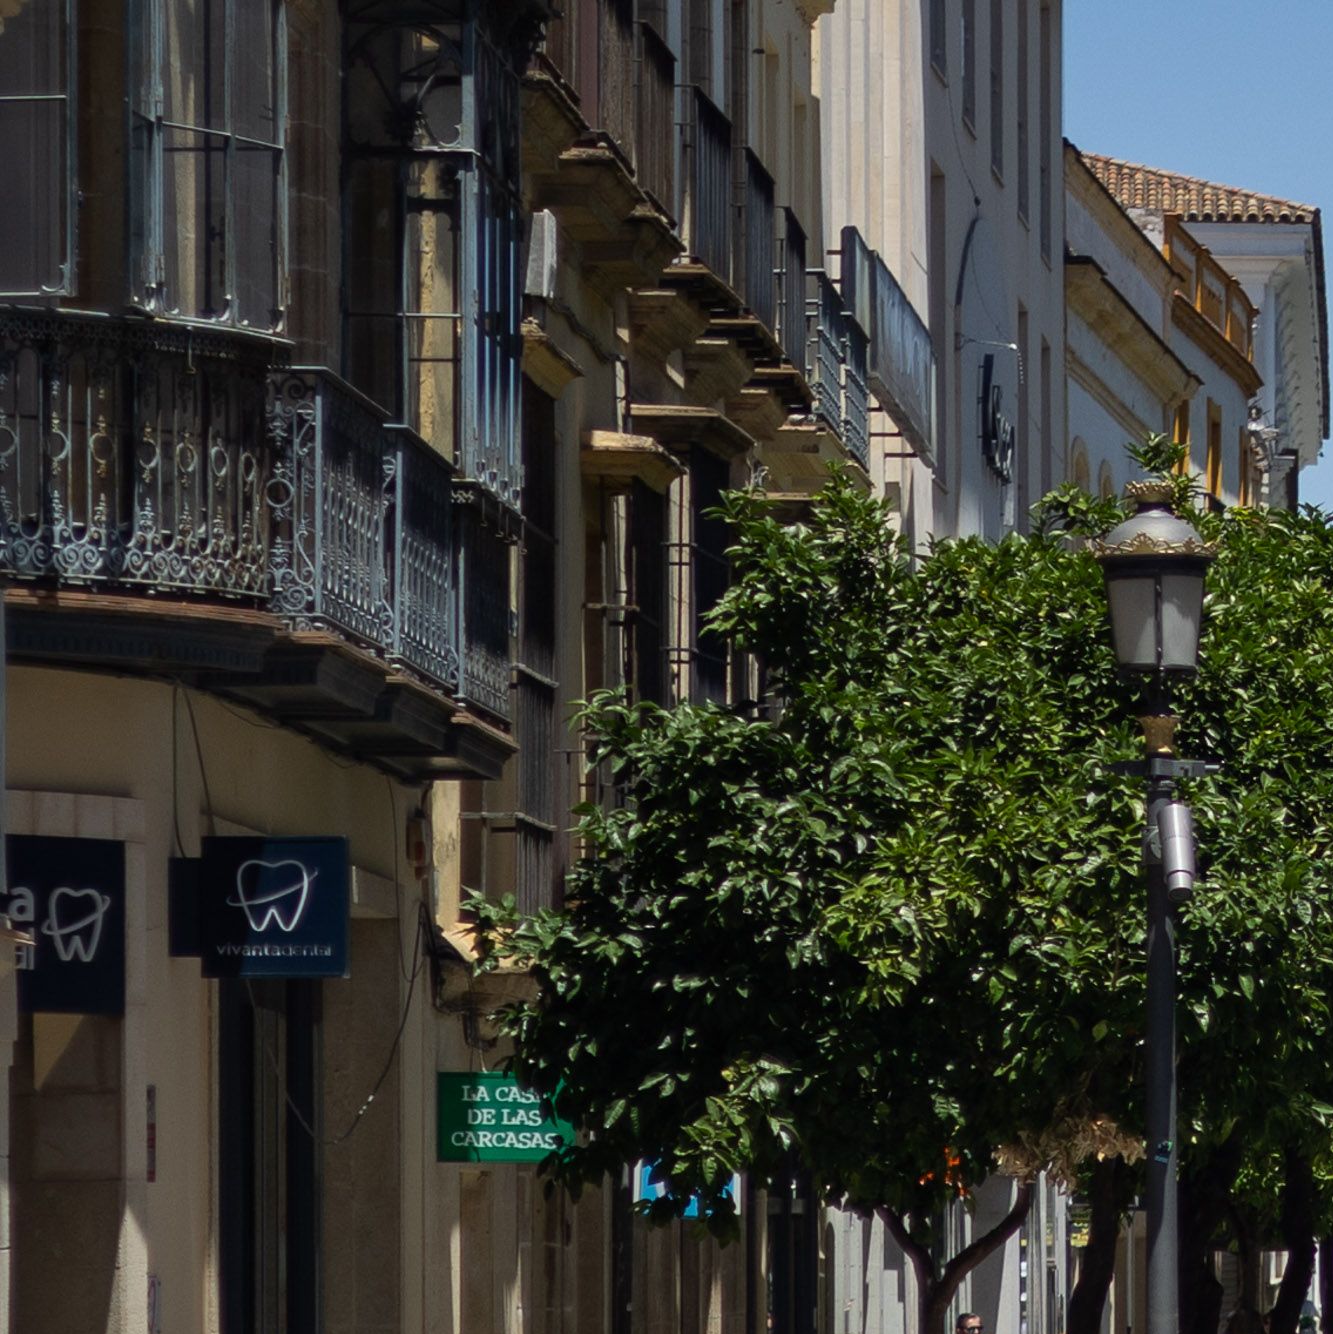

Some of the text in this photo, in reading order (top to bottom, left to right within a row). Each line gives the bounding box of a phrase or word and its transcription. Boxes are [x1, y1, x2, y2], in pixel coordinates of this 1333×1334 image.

[217, 942, 331, 956] vivantadental
[462, 1085, 541, 1103] LA CAS
[467, 1108, 542, 1127] DE LAS
[451, 1131, 559, 1149] CARCASAS
